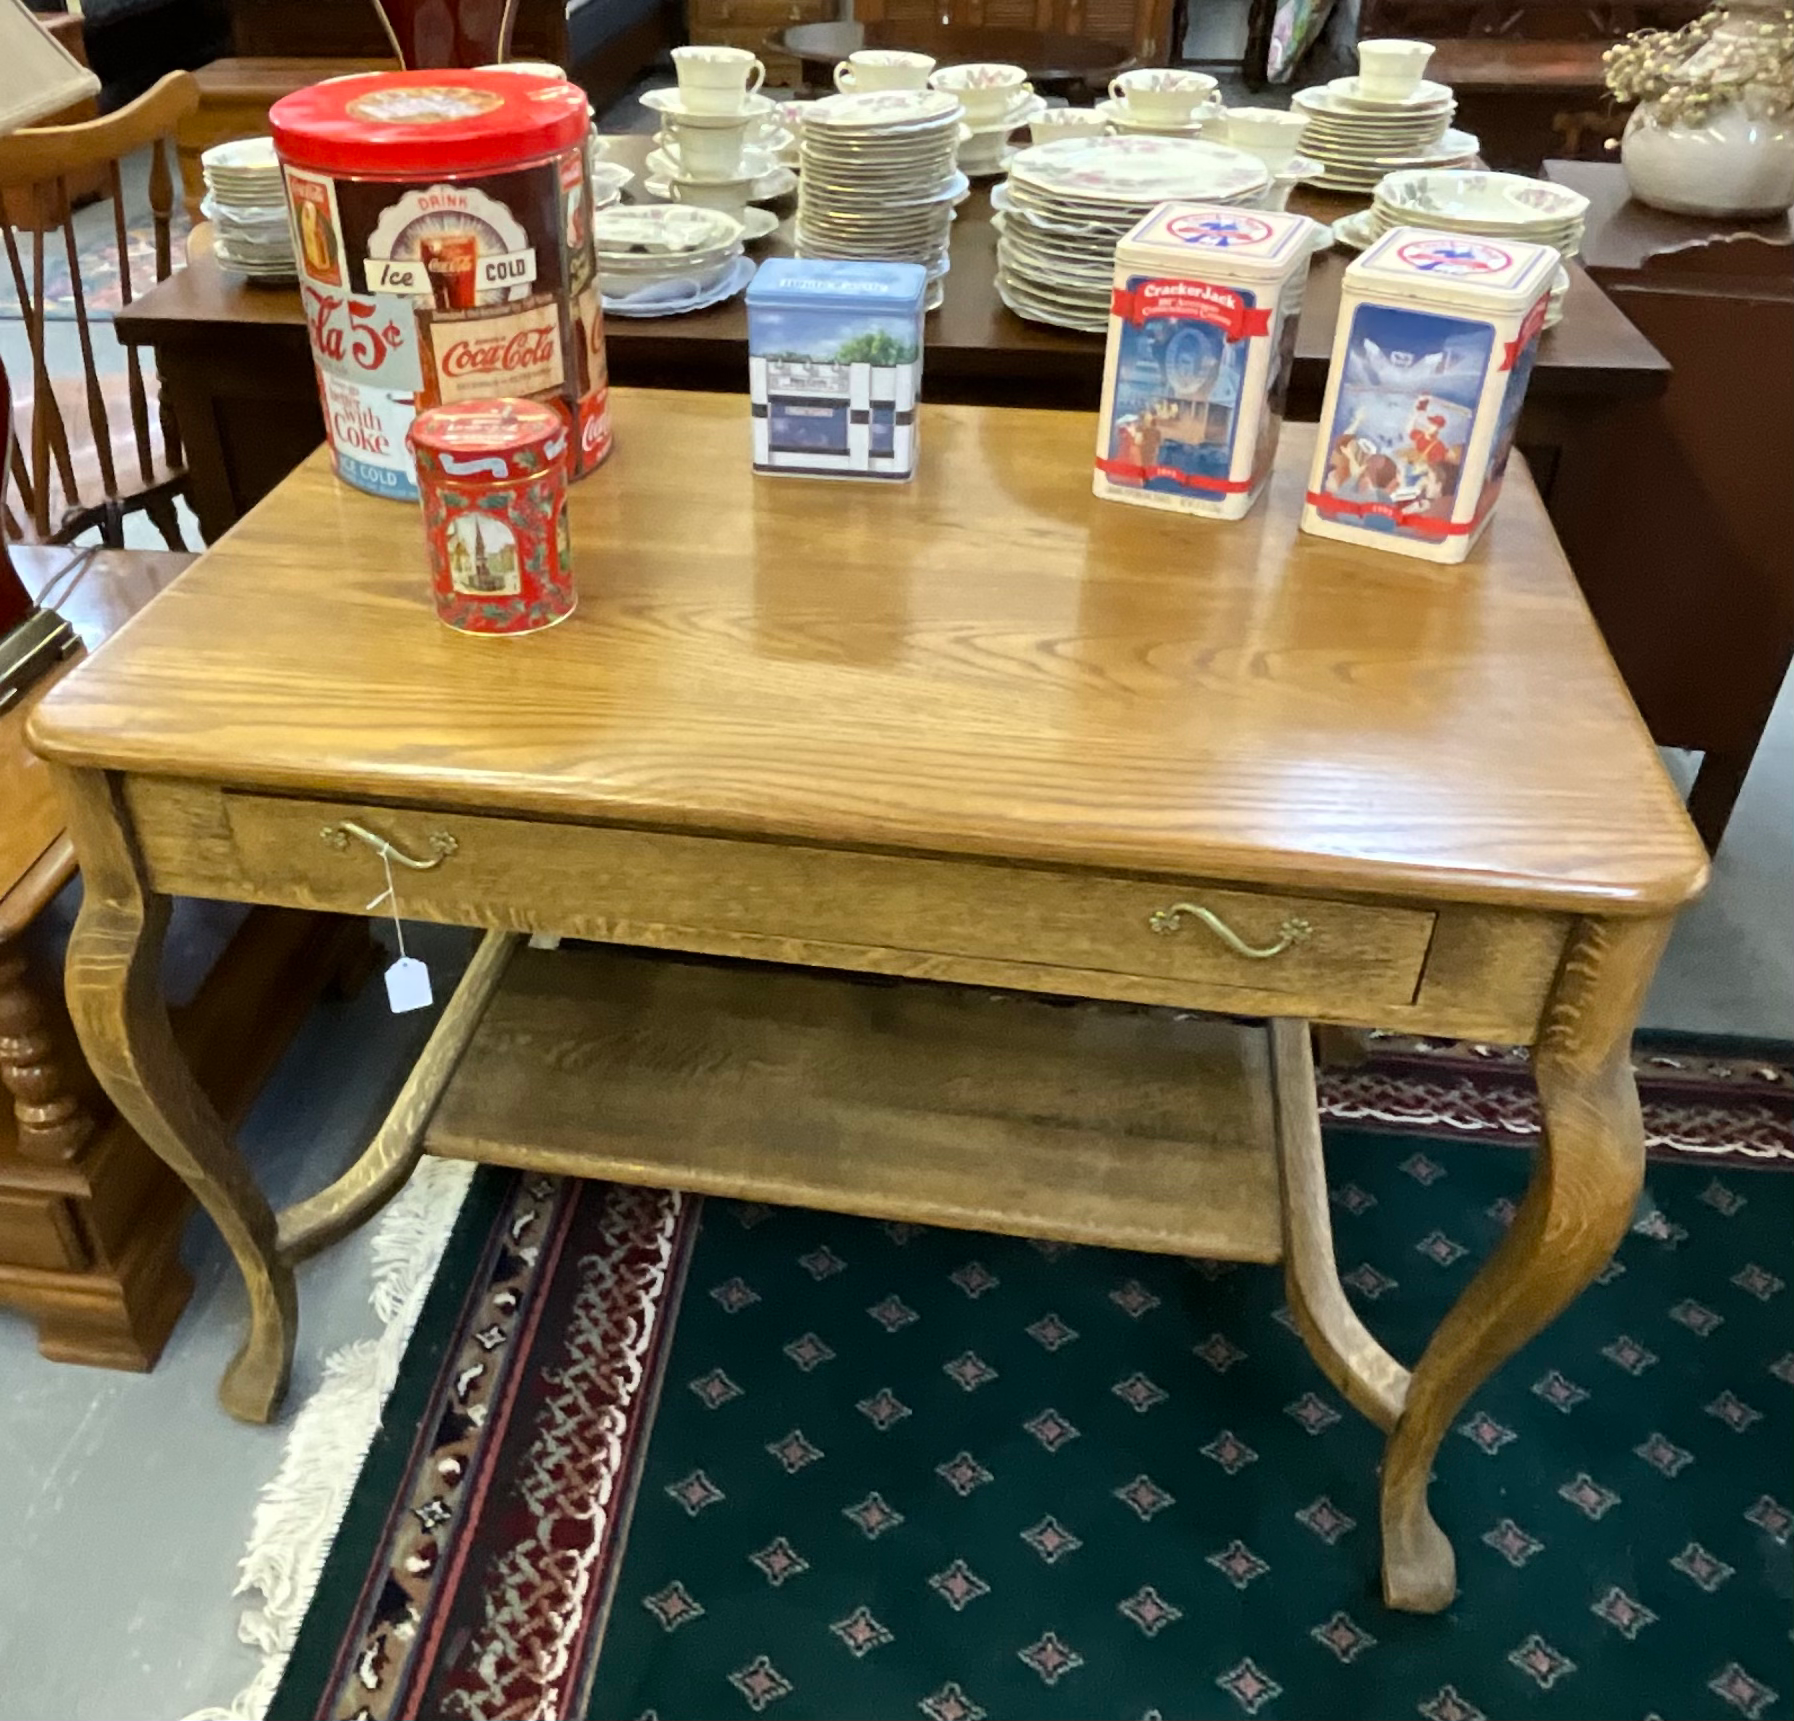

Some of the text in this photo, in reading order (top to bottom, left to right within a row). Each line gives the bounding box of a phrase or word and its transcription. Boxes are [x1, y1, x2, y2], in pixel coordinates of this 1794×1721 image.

[417, 194, 468, 211] DRINK
[381, 258, 526, 287] Ice COLD
[442, 323, 557, 378] Coca-Cola
[344, 406, 382, 432] with
[335, 412, 391, 456] Coke
[360, 465, 397, 486] COLD
